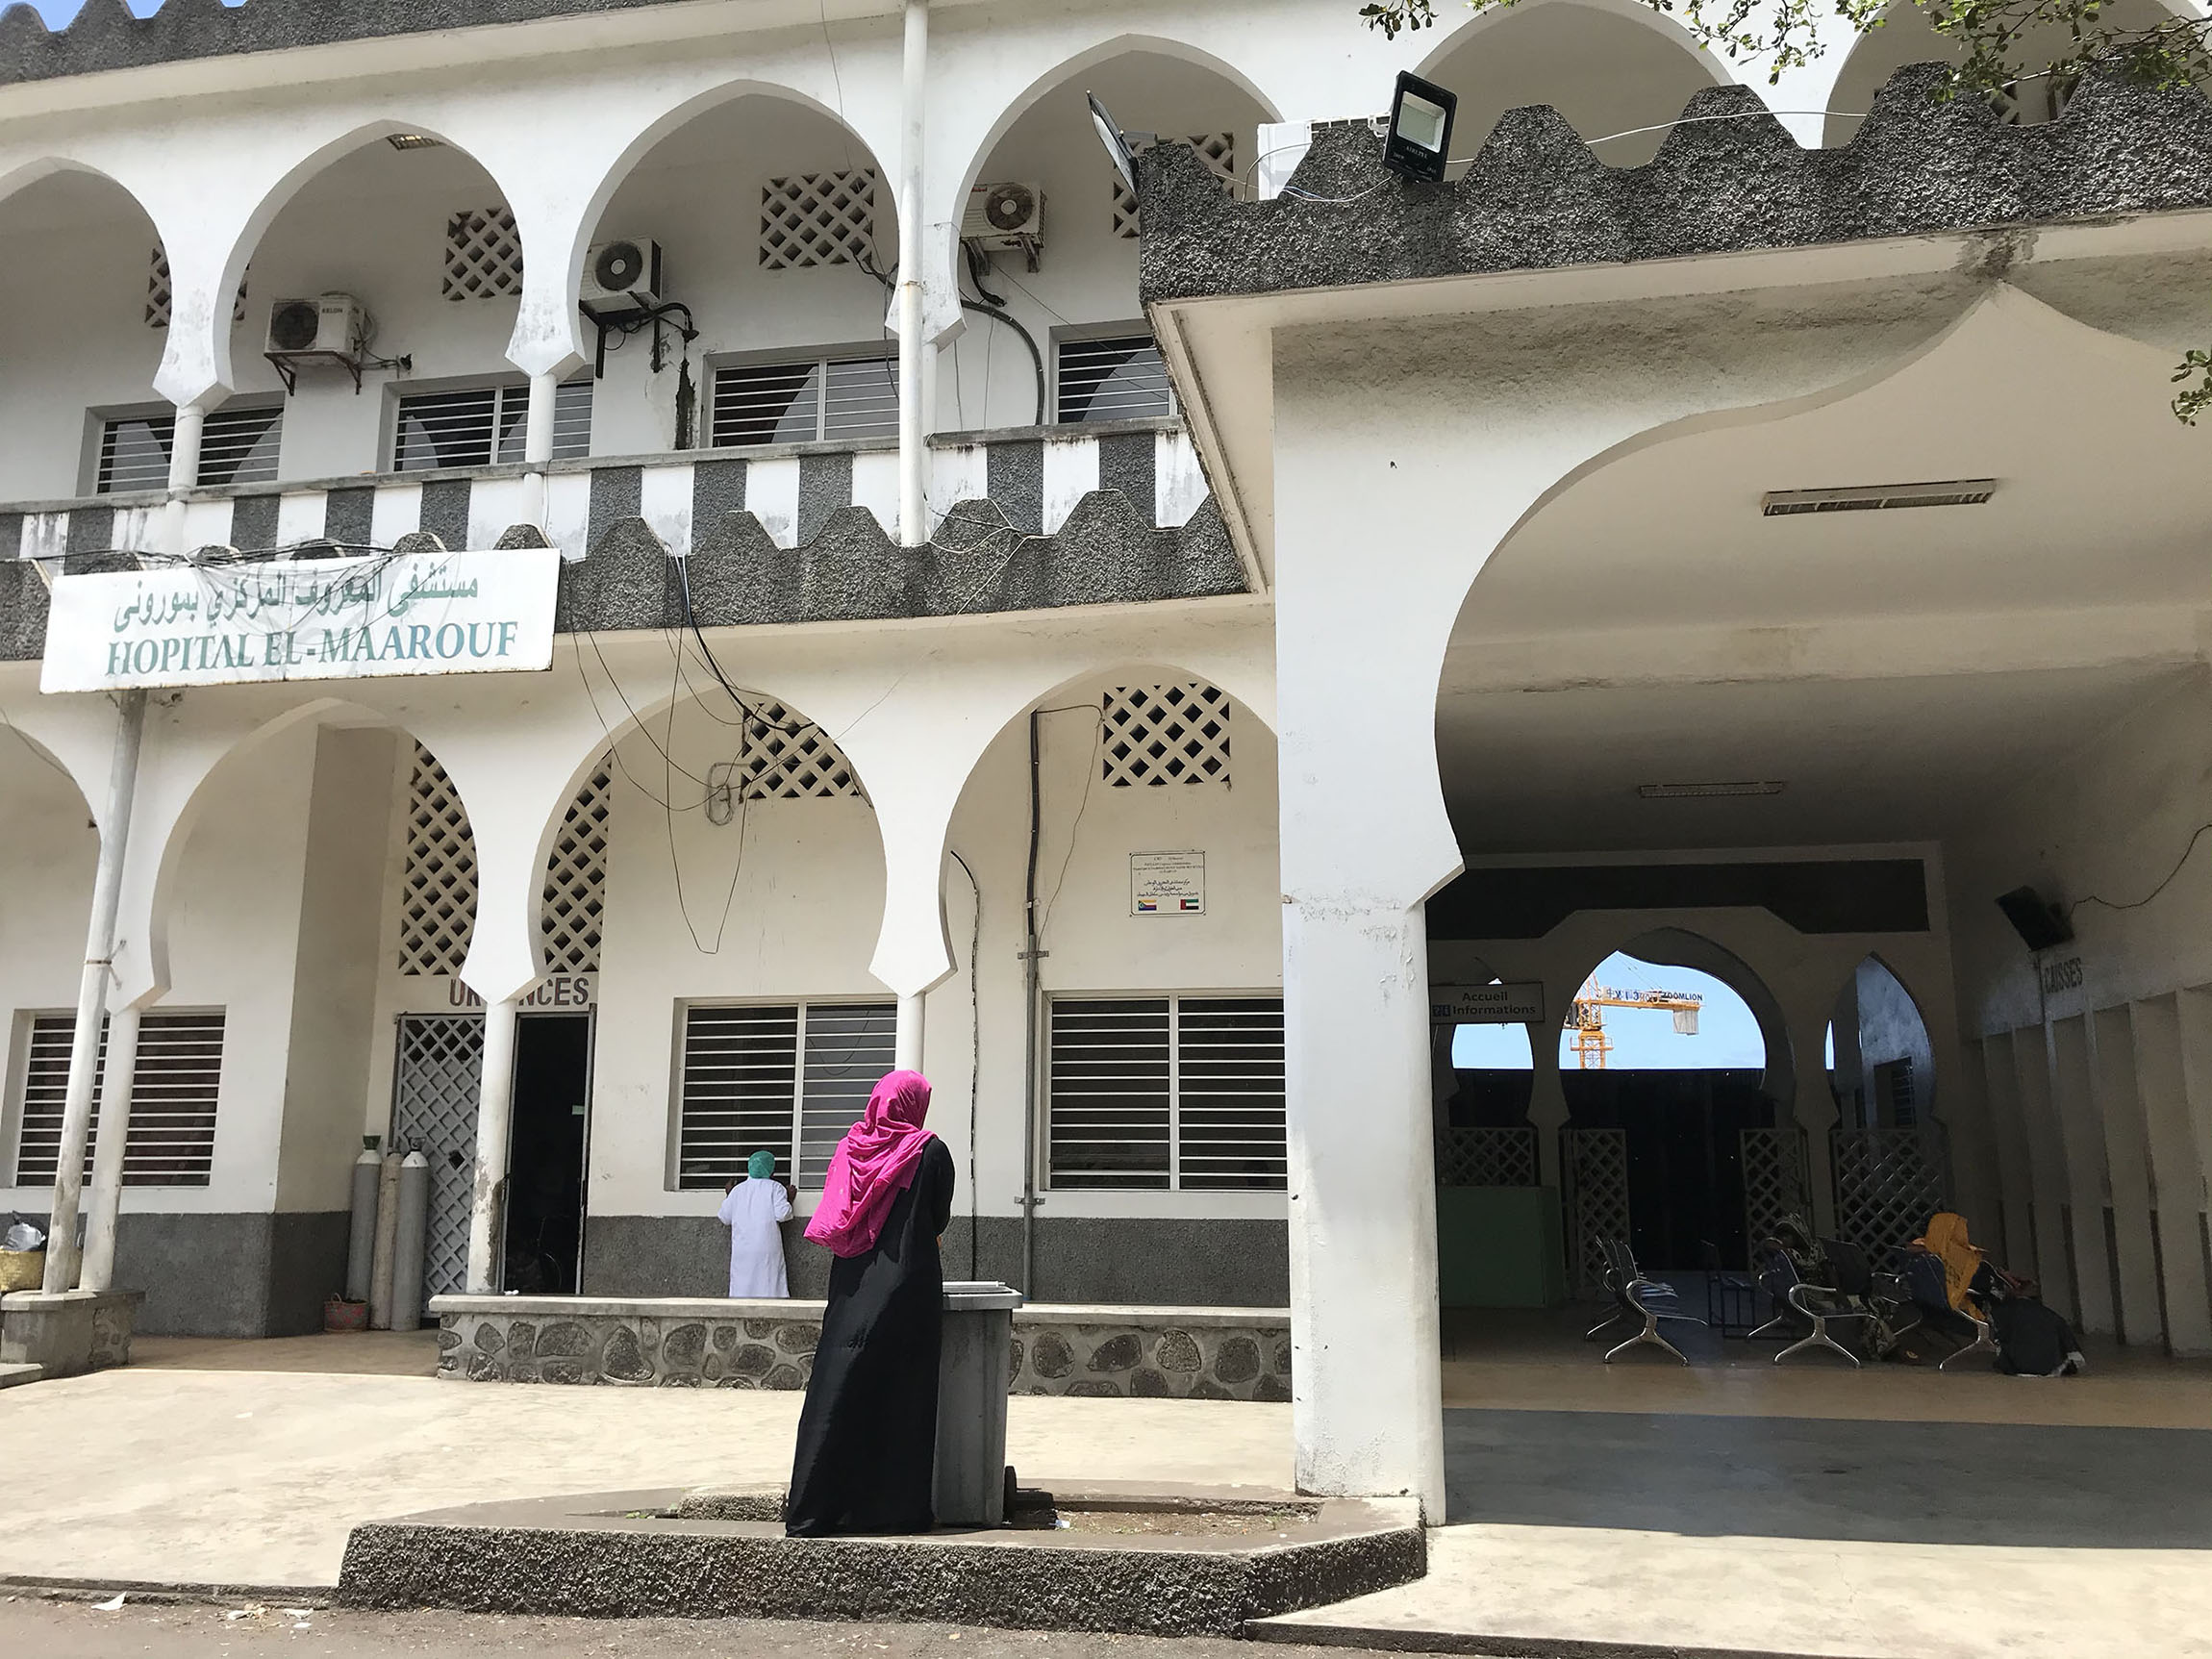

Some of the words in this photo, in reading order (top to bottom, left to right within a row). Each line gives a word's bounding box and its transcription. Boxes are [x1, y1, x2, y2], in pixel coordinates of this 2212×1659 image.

[388, 562, 478, 617] مستشفى
[105, 633, 255, 677] HOPITAL
[2044, 957, 2083, 993] CAISSES
[1453, 1005, 1536, 1016] Informations
[1462, 991, 1508, 1001] Accueil
